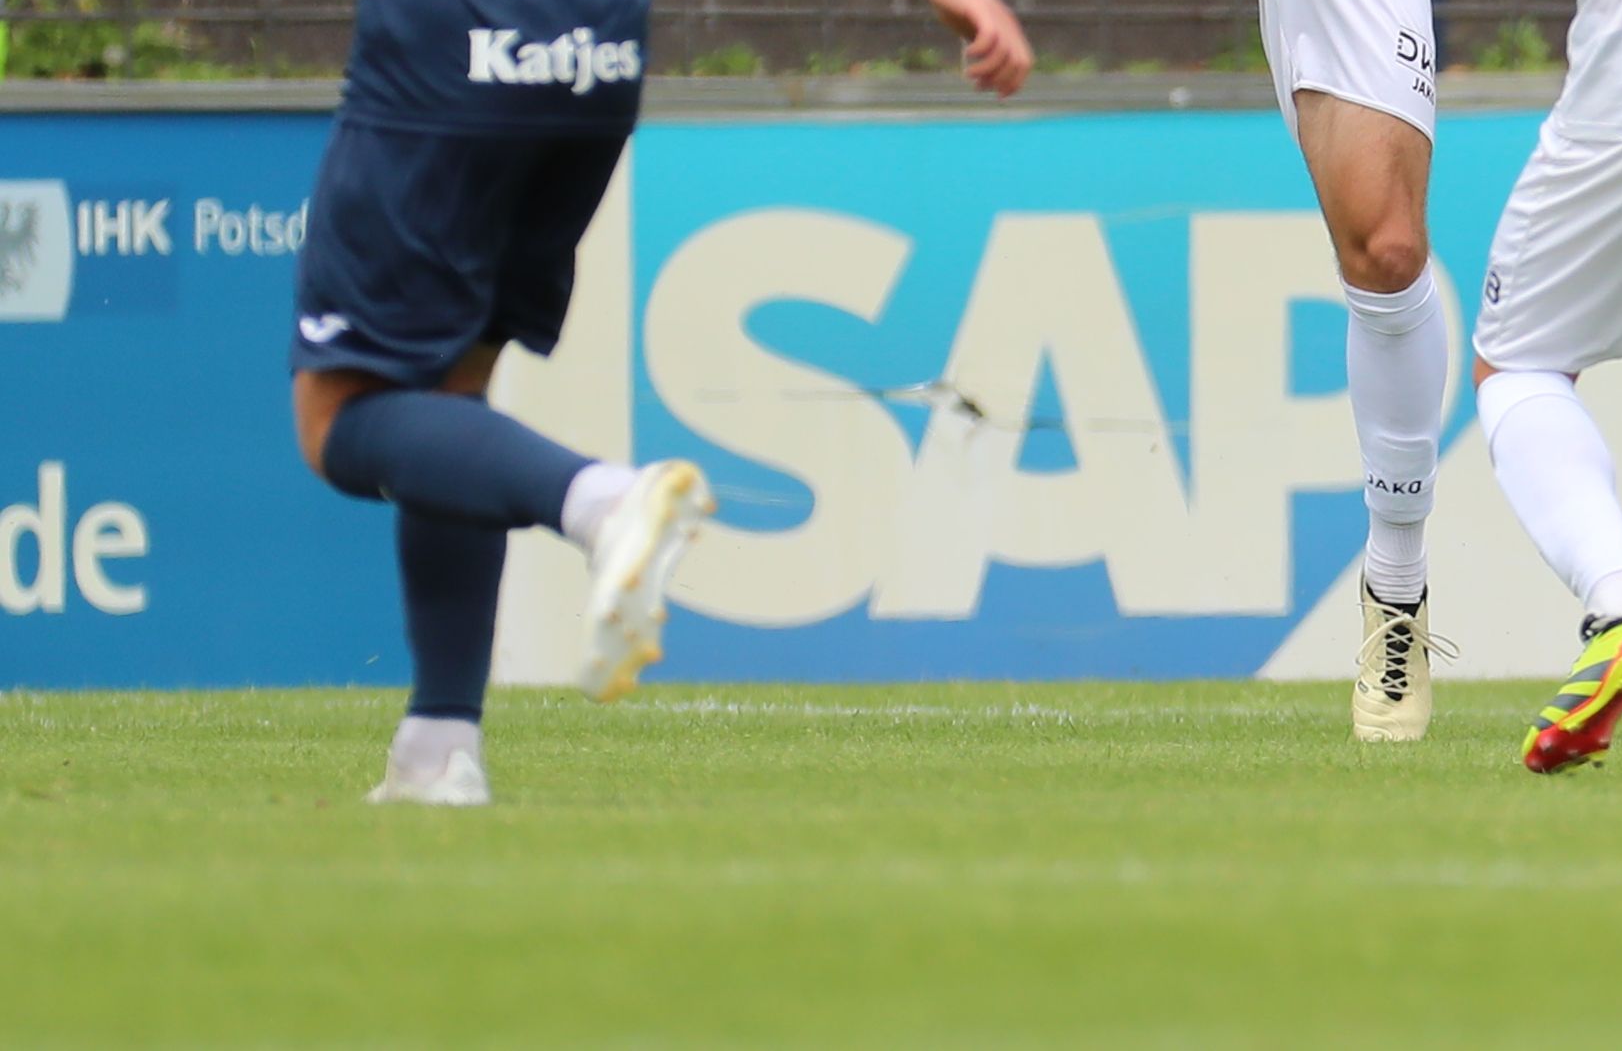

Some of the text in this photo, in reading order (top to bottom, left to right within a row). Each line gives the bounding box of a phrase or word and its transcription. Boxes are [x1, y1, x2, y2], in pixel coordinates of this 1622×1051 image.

[468, 27, 642, 95] Katjes
[77, 198, 173, 256] IHK
[643, 204, 1463, 628] SAP
[1366, 474, 1423, 495] JAKO
[0, 460, 150, 617] de
